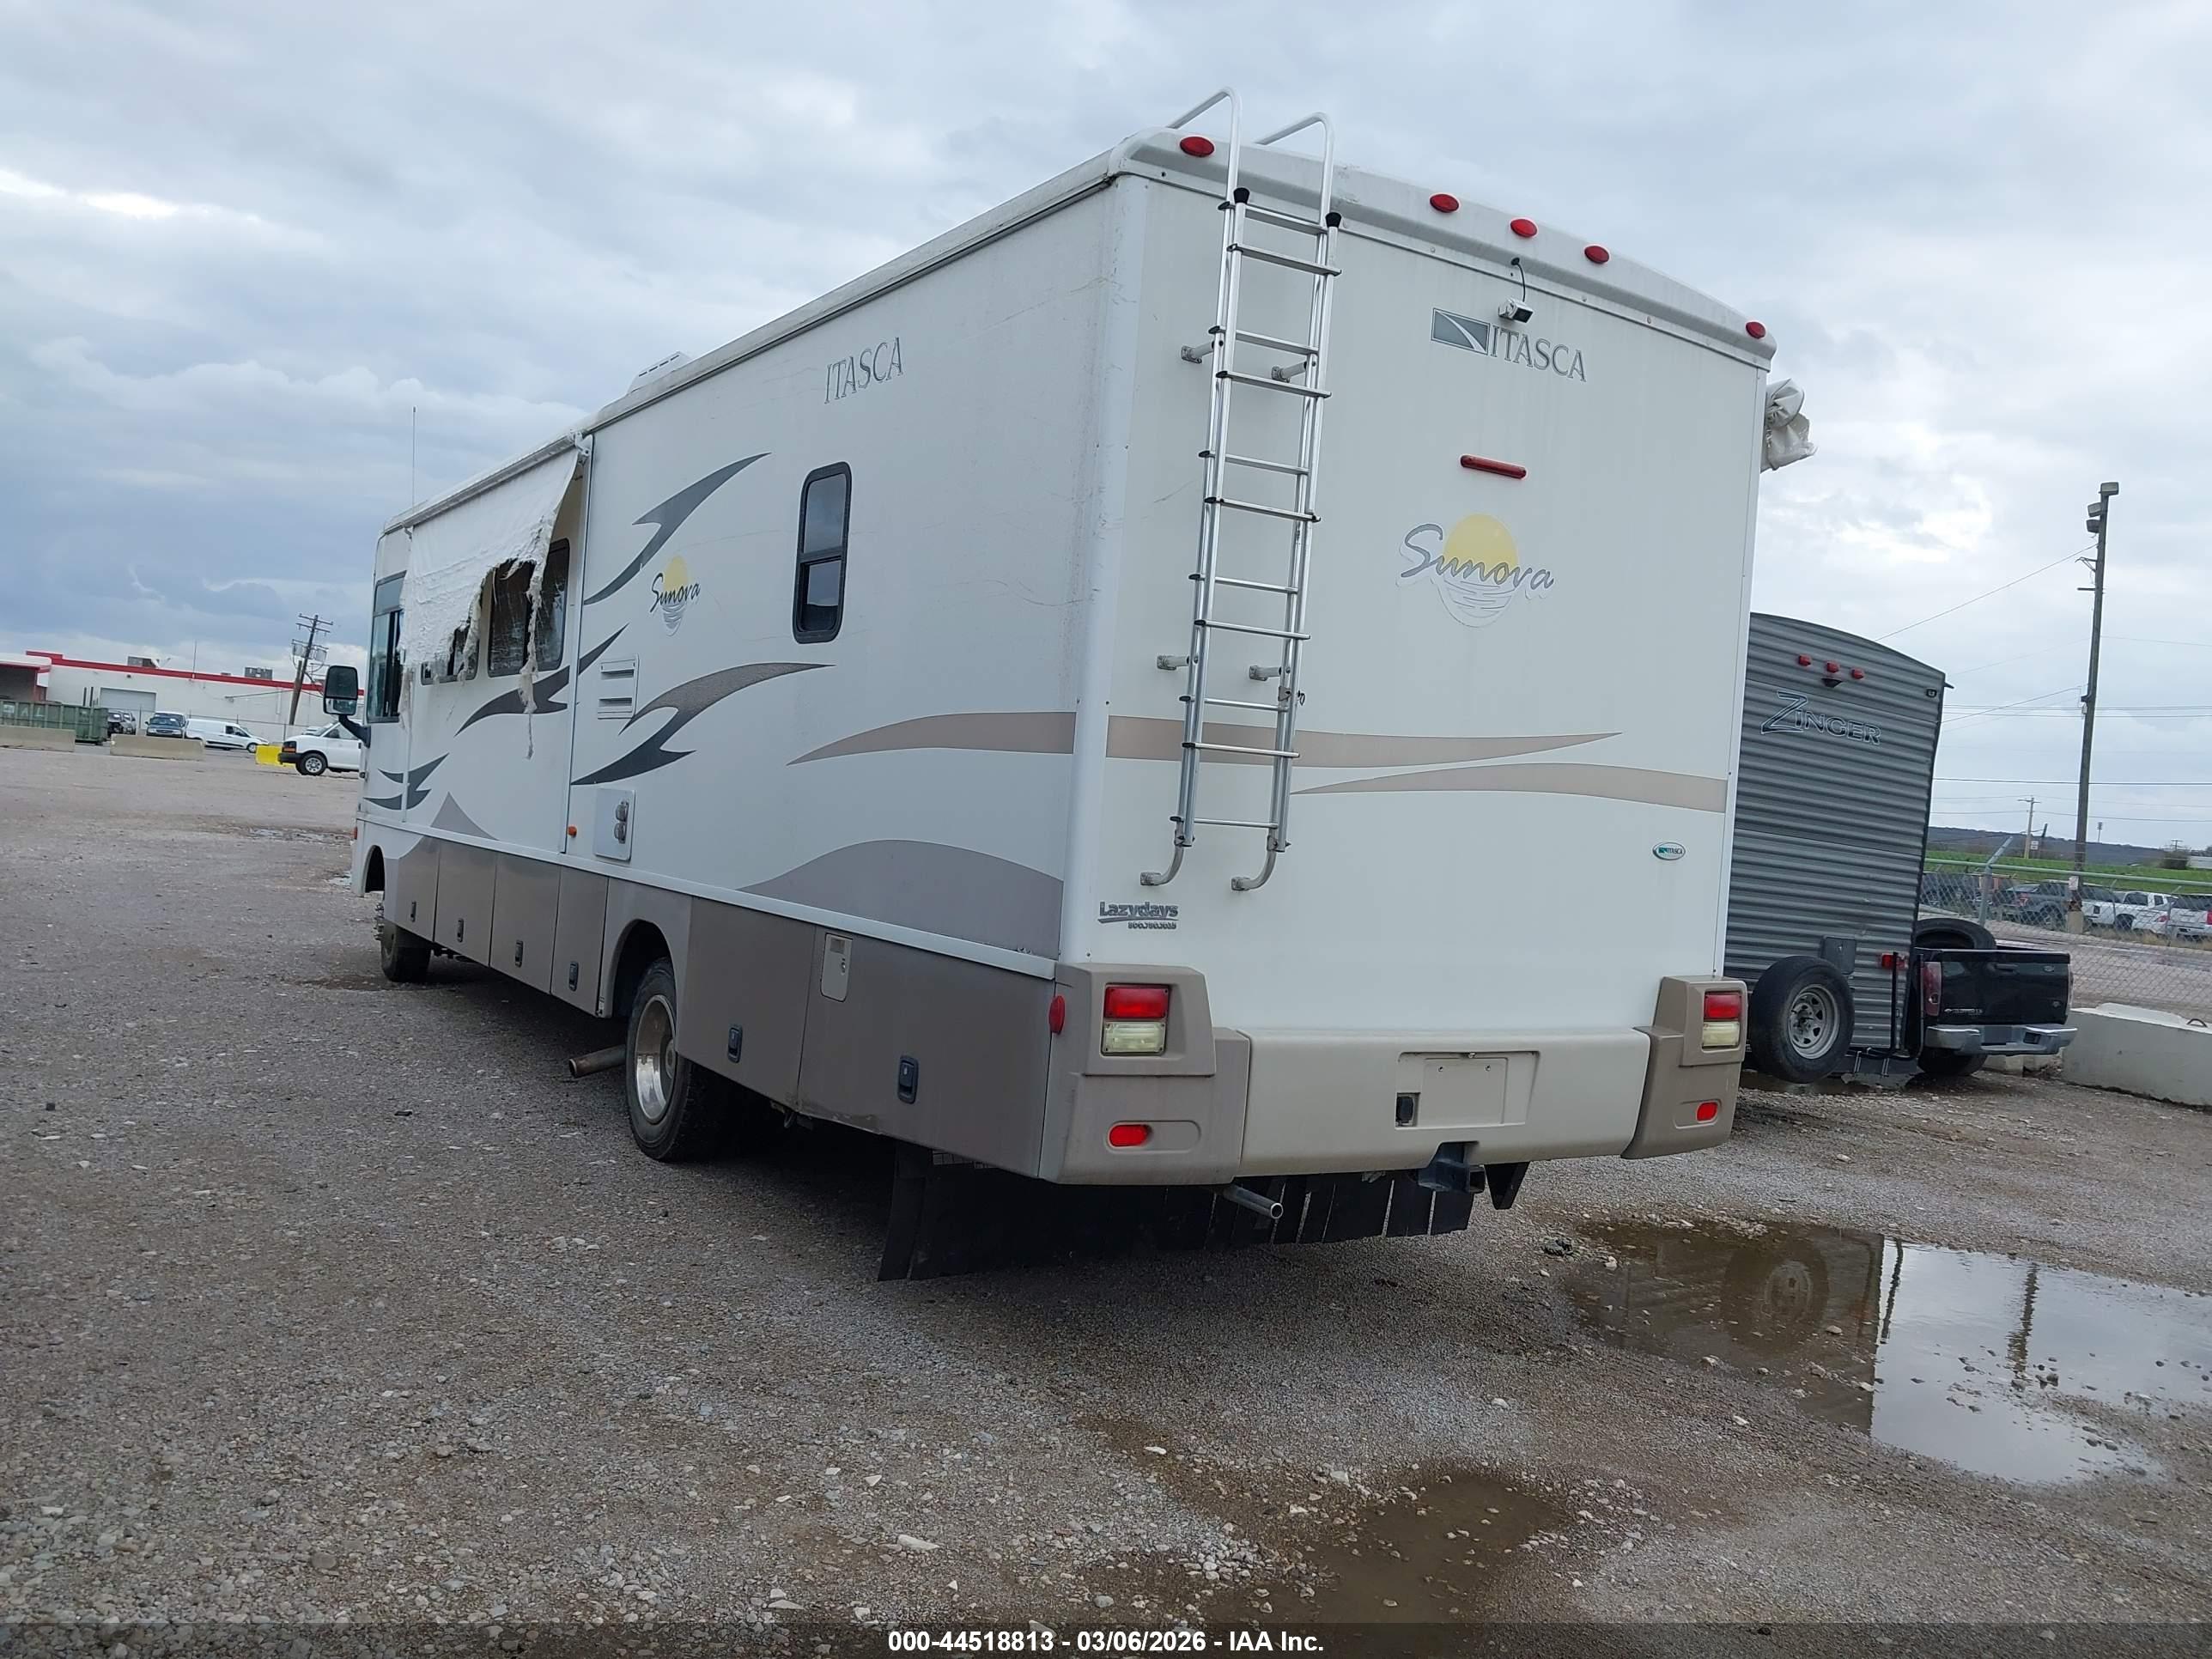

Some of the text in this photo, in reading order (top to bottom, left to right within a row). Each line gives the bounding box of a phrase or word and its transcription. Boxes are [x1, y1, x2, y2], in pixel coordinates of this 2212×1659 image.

[823, 336, 904, 405] ITASCA
[1490, 324, 1587, 383] ITASCA
[1401, 522, 1555, 591] Sunova
[649, 571, 702, 613] Sunova
[1099, 900, 1179, 919] Lazydays
